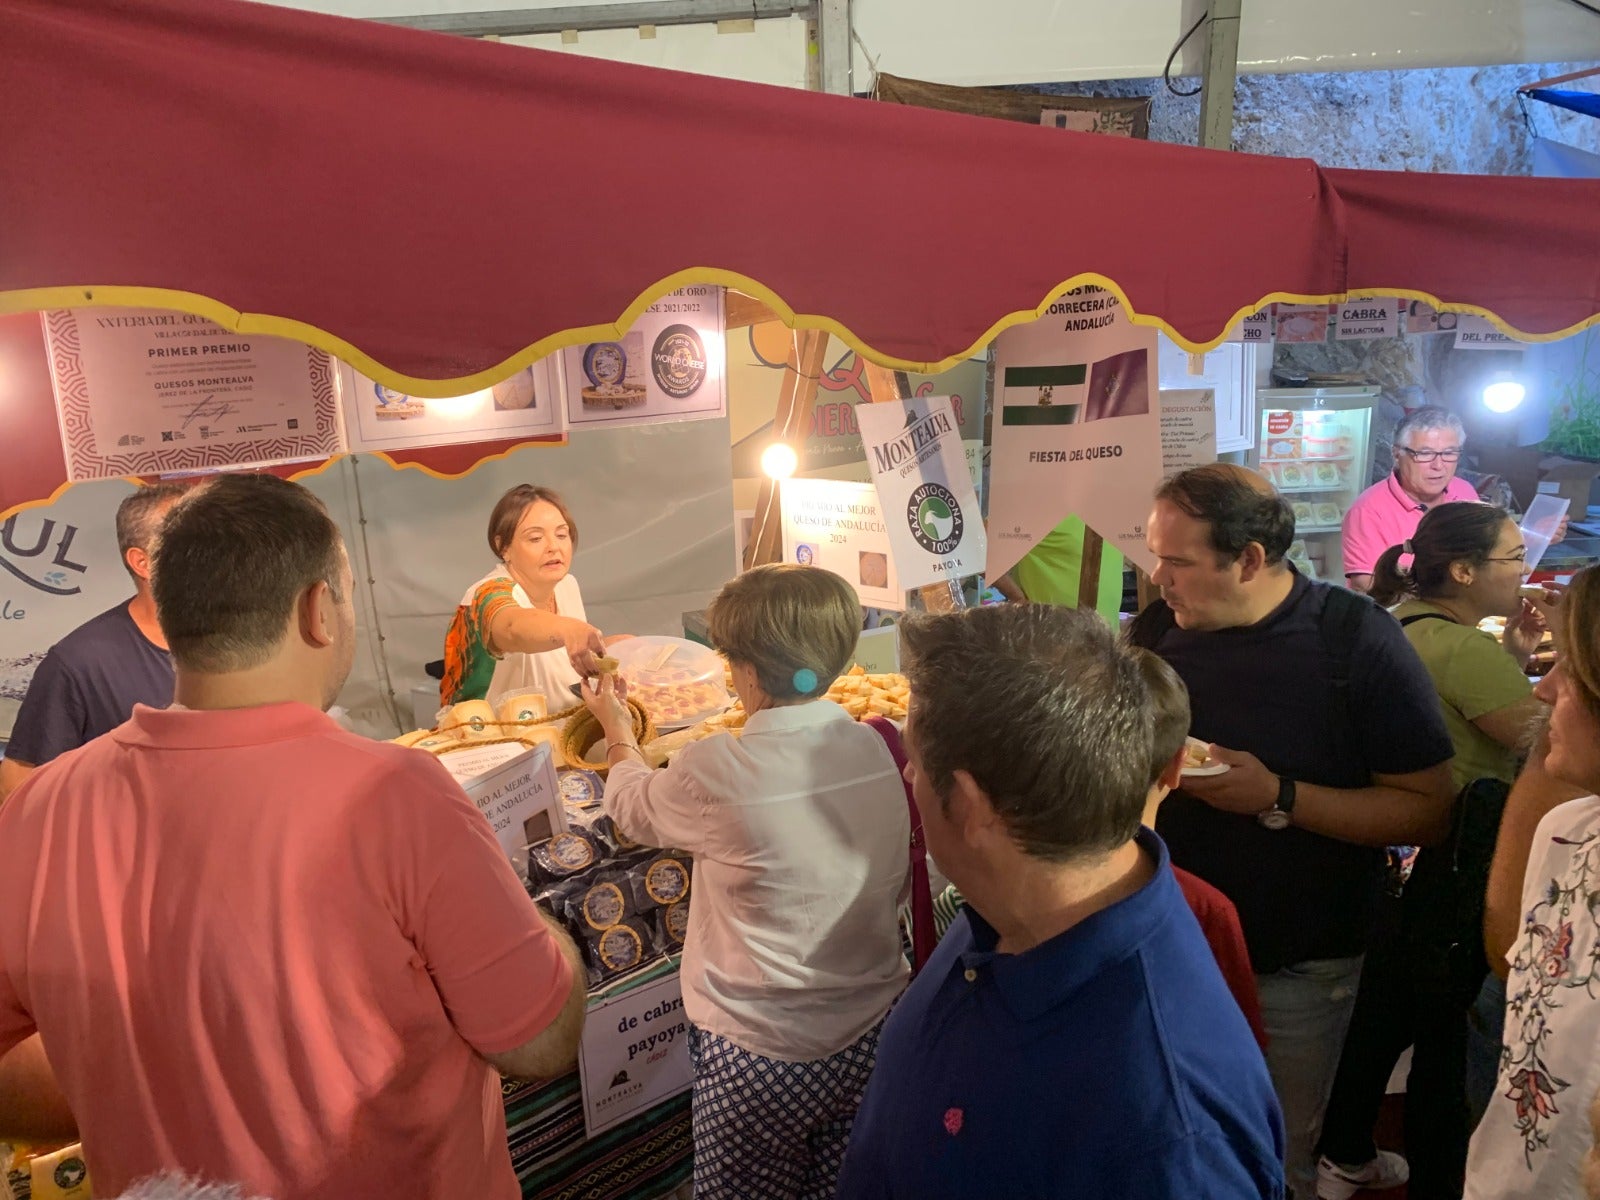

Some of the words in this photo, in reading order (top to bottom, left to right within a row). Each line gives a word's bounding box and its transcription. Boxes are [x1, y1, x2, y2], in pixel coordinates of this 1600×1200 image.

[673, 288, 685, 297] DE
[687, 287, 707, 297] ORO
[663, 303, 700, 313] 2021/2022
[1342, 308, 1387, 320] CABRA
[1065, 313, 1115, 332] ANDALUCÍA
[1462, 333, 1482, 341] DEL
[148, 346, 198, 358] PRIMER
[202, 343, 252, 355] PREMIO
[154, 379, 194, 390] QUESOS
[197, 375, 254, 387] MONTEALVA
[872, 412, 952, 474] MONTEALVA
[1029, 450, 1066, 463] FIESTA
[1069, 449, 1084, 462] DEL
[1086, 445, 1122, 460] QUESO
[847, 504, 877, 516] MEJOR
[914, 484, 962, 526] AUTOCTONA
[835, 519, 887, 533] ANDALUCÍA
[910, 504, 923, 538] RAZA
[829, 533, 847, 544] 2024
[931, 537, 959, 553] 100%
[0, 600, 26, 620] le
[492, 788, 504, 801] AL
[504, 773, 531, 793] MEJOR
[496, 783, 544, 815] ANDALUCÍA
[493, 816, 511, 833] 2024
[617, 1016, 638, 1034] de
[627, 1021, 686, 1061] payoya
